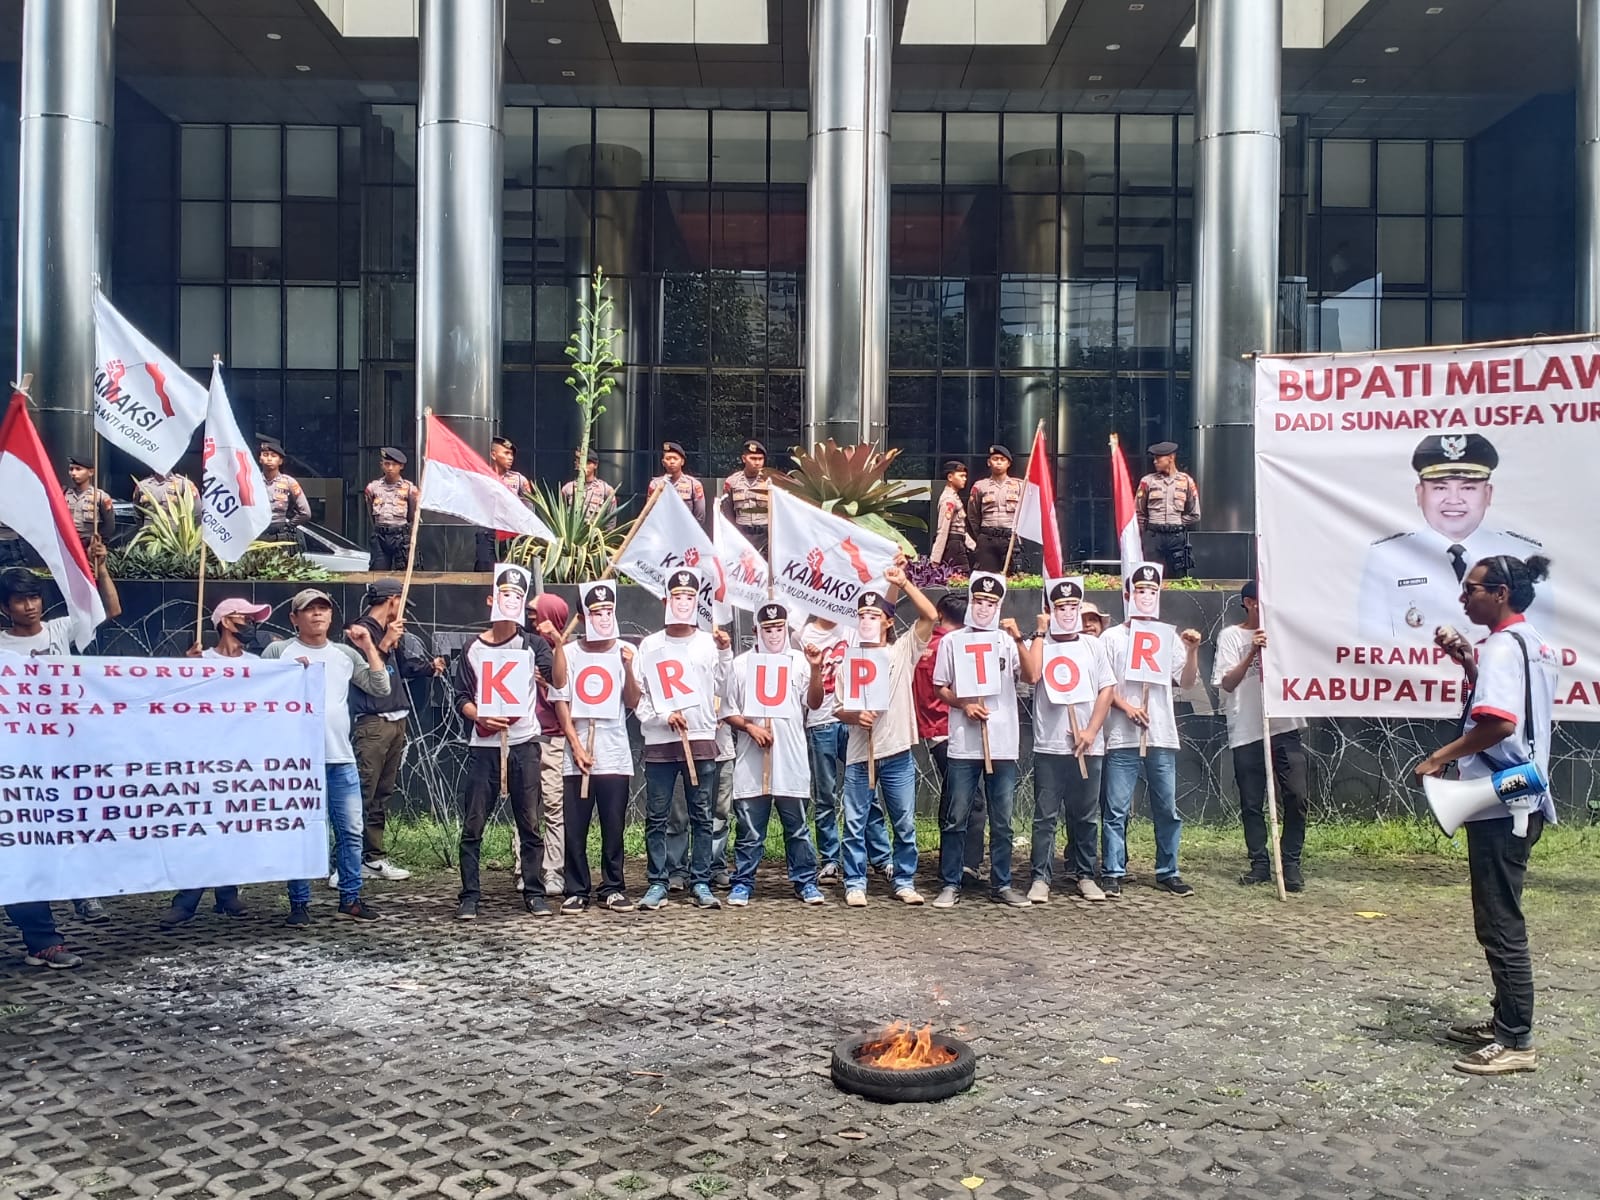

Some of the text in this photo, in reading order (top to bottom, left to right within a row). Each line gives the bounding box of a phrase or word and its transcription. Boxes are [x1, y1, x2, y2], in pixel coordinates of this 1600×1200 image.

[95, 367, 163, 432] AMAKSI
[1278, 363, 1432, 402] BUPATI
[118, 423, 160, 453] KORUPSI
[1274, 412, 1333, 432] DADI
[1341, 408, 1468, 431] SUNARYA
[1474, 405, 1544, 427] USFA
[201, 468, 239, 518] AKSI
[781, 559, 861, 602] KAMAKSI
[1, 664, 251, 678] ANTI KORUPSI
[965, 643, 992, 685] T
[1130, 631, 1161, 673] R
[481, 660, 520, 705] K
[575, 665, 614, 705] O
[656, 659, 694, 699] R
[755, 664, 788, 706] U
[849, 658, 877, 699] P
[1044, 655, 1081, 693] O
[150, 701, 313, 714] KORUPTOR
[0, 758, 311, 780] SAK KPK PERIKSA DAN
[3, 777, 322, 802] NTAS DUGAAN SKANDAL
[0, 797, 321, 825] ORUPSI BUPATI MELAWI
[0, 817, 305, 847] SUNARYA USFA YURSA
